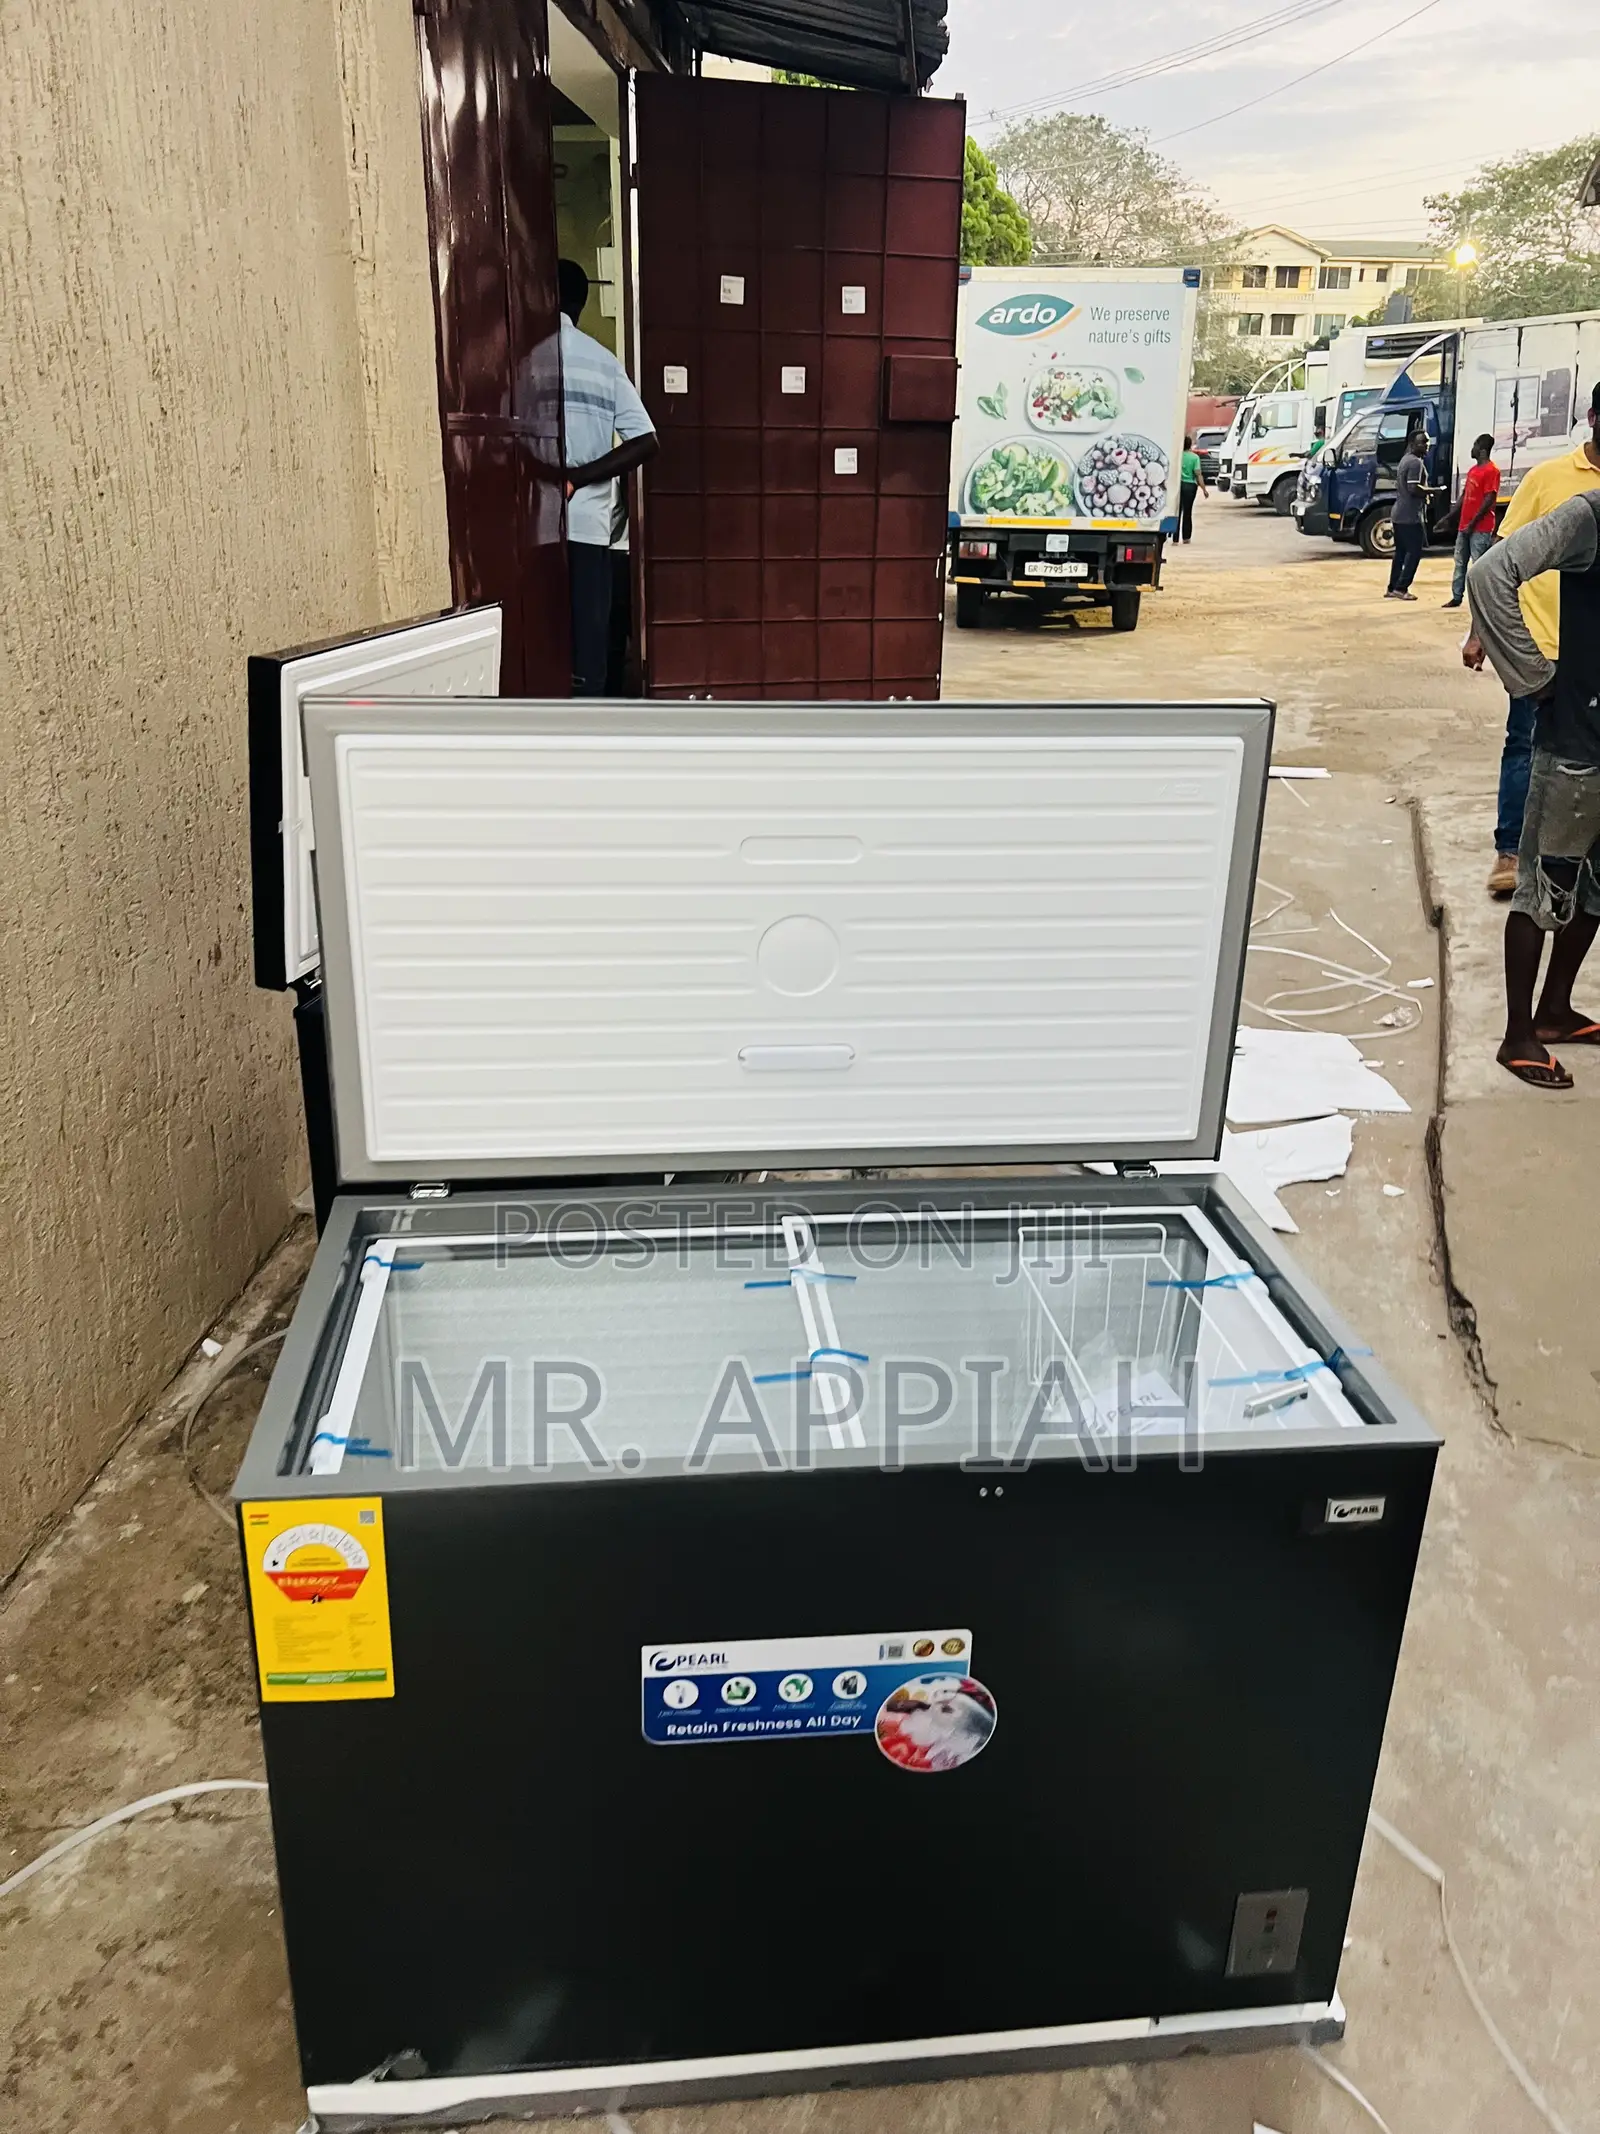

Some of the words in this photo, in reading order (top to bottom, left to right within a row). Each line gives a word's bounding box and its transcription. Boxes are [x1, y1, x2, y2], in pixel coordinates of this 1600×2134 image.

[988, 302, 1057, 324] ardo
[1090, 306, 1111, 321] We
[1115, 307, 1170, 324] preserve
[1088, 328, 1140, 343] nature's
[1144, 328, 1171, 346] gifts
[1349, 1505, 1380, 1515] PEARL
[677, 1652, 729, 1667] PEARL
[666, 1721, 718, 1737] Retain
[722, 1717, 802, 1734] Freshness
[806, 1715, 827, 1729] All
[830, 1714, 862, 1729] Day
